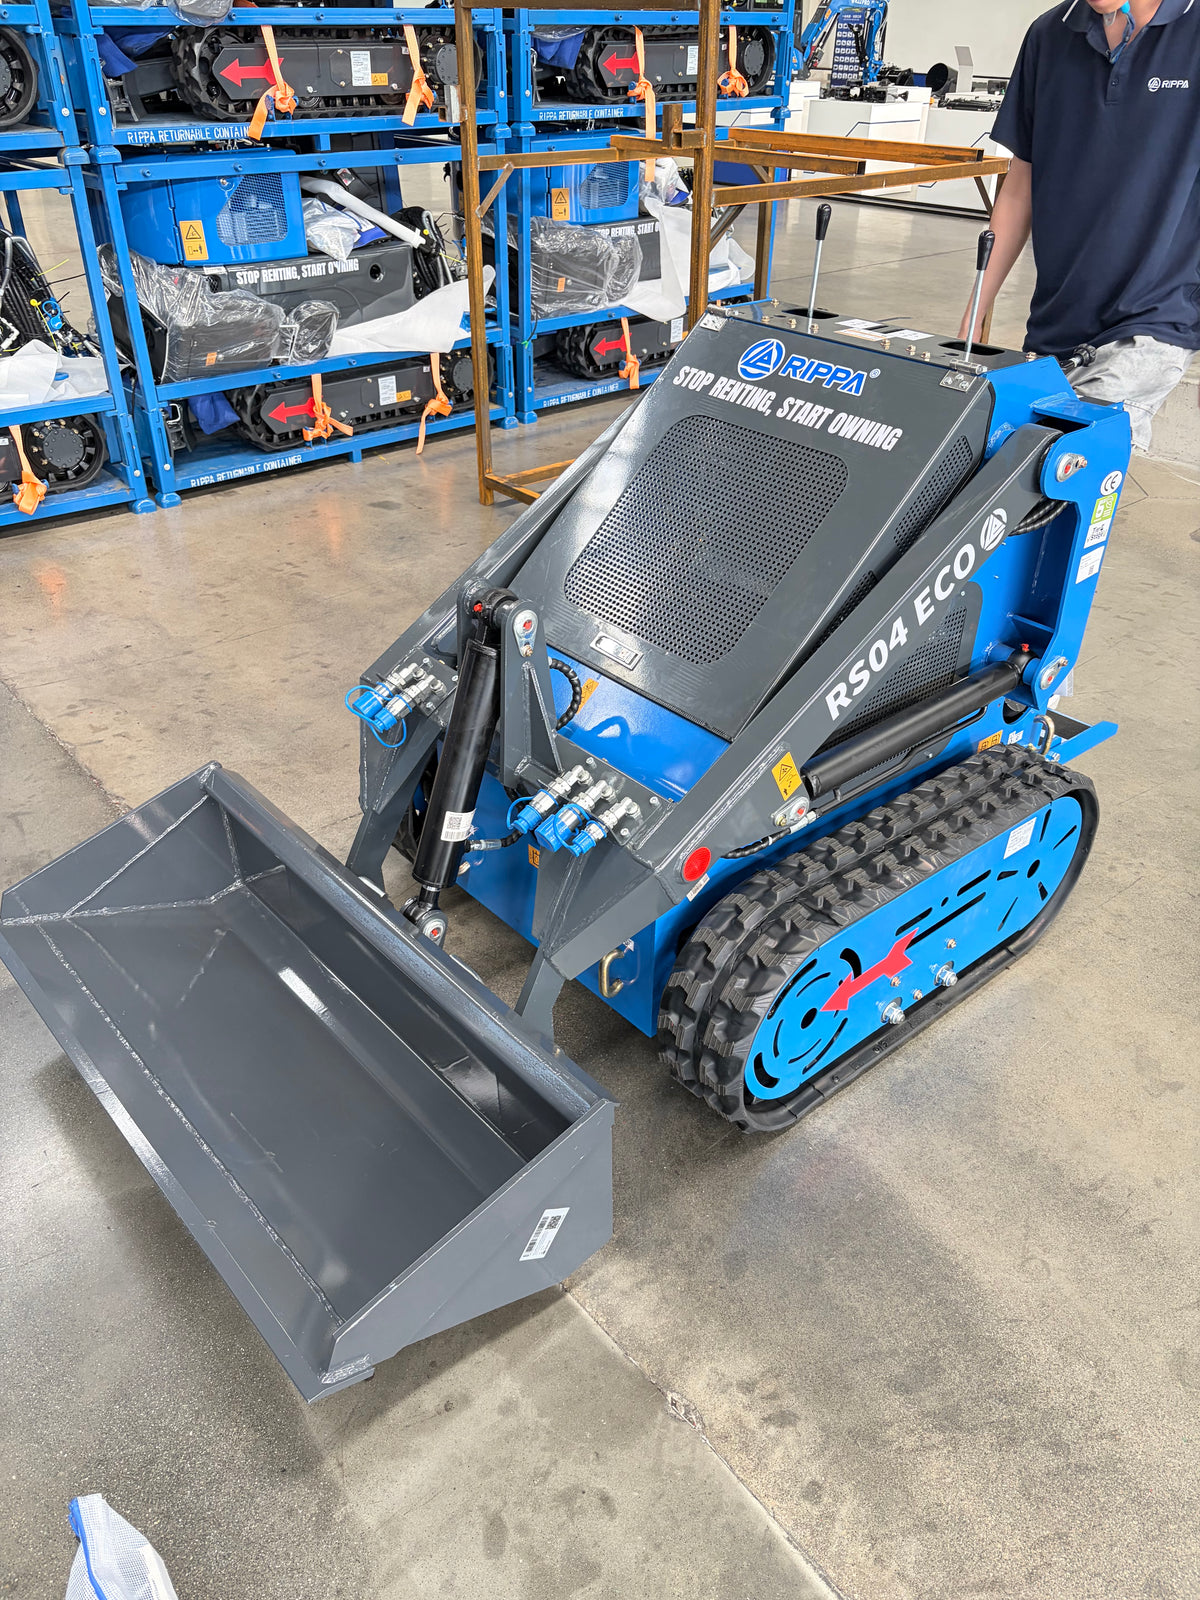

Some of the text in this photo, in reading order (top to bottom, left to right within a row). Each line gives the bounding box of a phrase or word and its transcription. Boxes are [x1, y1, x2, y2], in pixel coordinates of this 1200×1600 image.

[1161, 79, 1189, 88] RIPPA
[539, 107, 624, 121] RIPPA RETURNABLE CONTAINER
[127, 126, 250, 144] RIPPA RETURNABLE CONTAIN
[637, 222, 655, 235] START
[235, 271, 260, 285] STOP
[262, 266, 301, 281] RENTING,
[301, 262, 327, 278] START
[776, 353, 868, 397] RIPPA
[672, 365, 904, 452] STOP RENTING, START OWNING
[190, 454, 303, 488] RIPPA RETURNABLE CONTAINER
[824, 543, 976, 722] RS04 ECO
